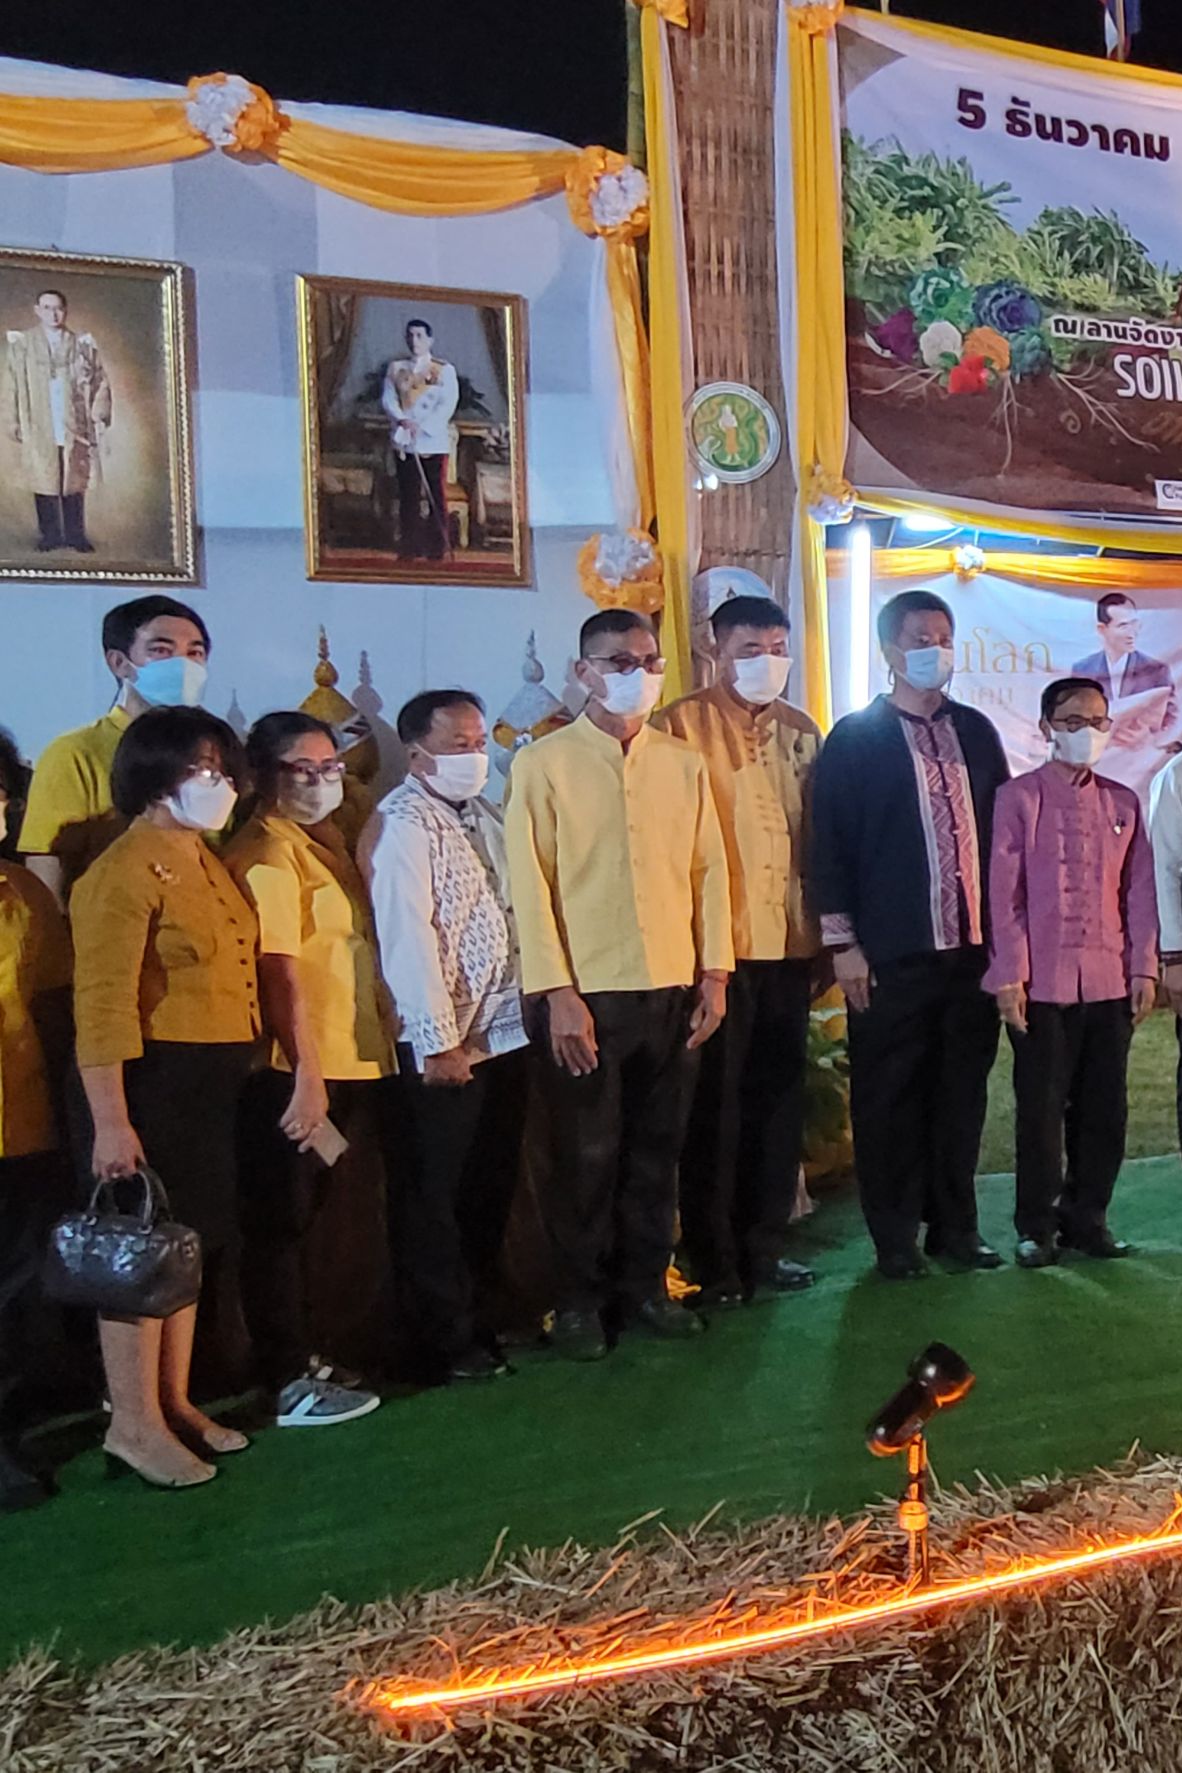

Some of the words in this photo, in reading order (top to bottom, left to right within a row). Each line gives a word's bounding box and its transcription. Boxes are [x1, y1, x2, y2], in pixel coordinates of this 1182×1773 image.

[958, 88, 986, 130] 5
[1005, 97, 1170, 162] ธันวาคม
